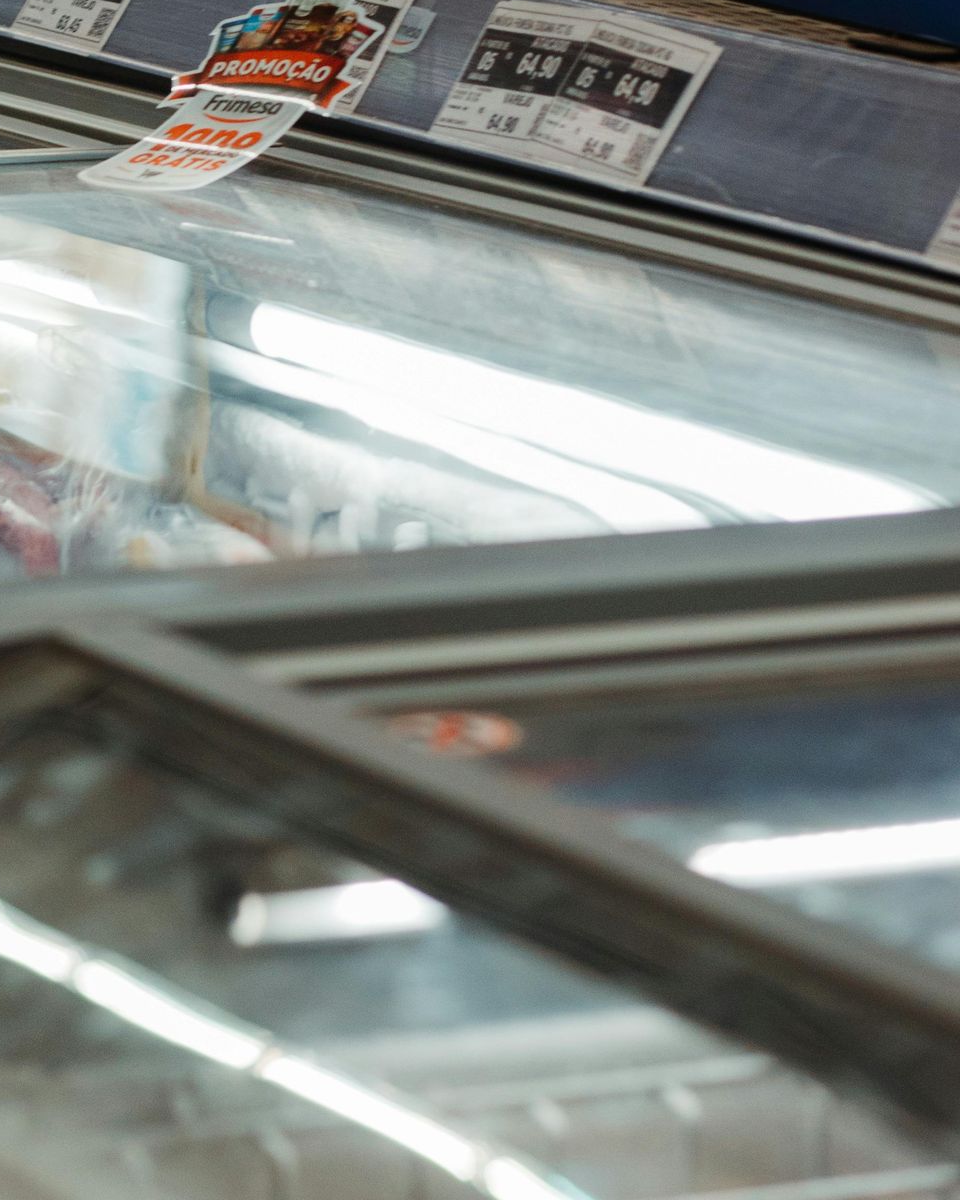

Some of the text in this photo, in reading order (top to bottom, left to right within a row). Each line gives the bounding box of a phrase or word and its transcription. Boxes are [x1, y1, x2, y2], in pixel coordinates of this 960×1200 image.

[209, 57, 331, 83] PROMOÇÃO
[515, 52, 562, 80] 64,90
[613, 73, 661, 106] 64,90
[203, 94, 283, 115] Frimesa
